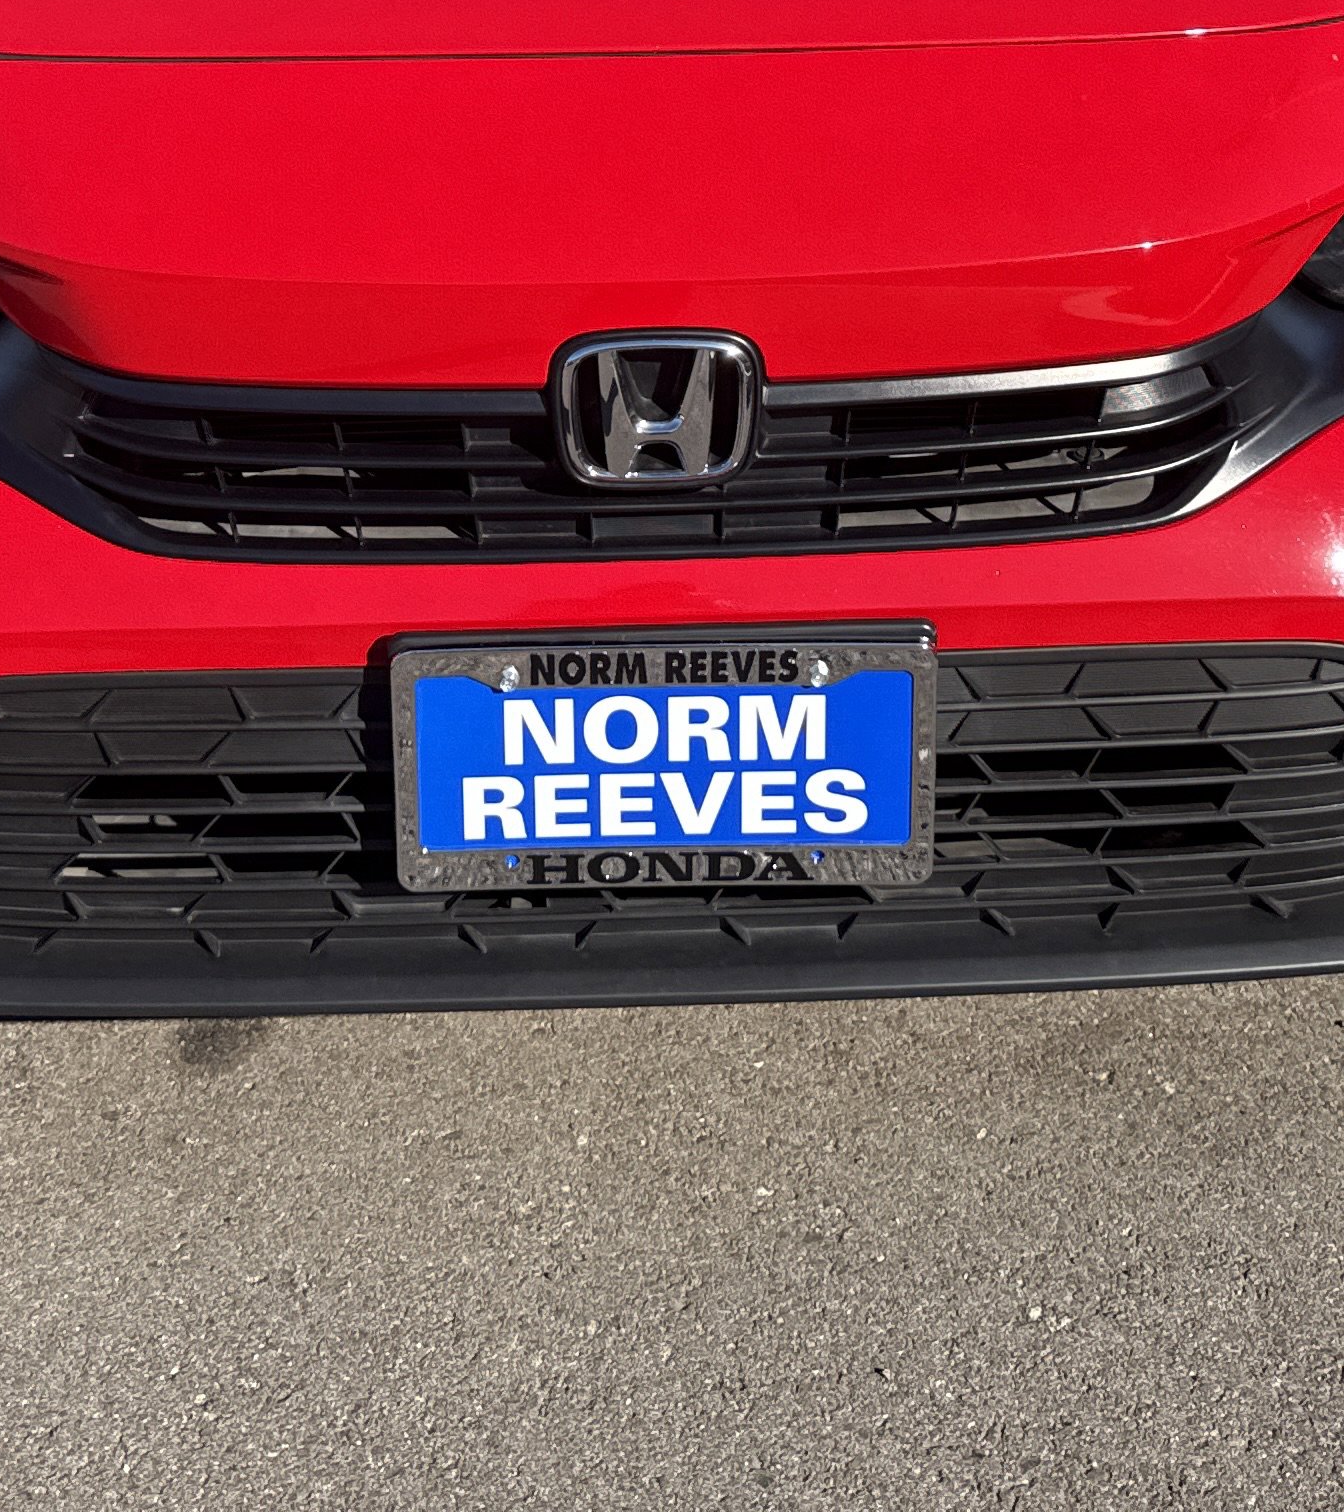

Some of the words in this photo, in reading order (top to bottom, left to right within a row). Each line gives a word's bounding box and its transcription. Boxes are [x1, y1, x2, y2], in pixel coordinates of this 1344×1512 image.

[530, 652, 648, 686] NORM
[665, 649, 799, 684] REEVES
[503, 694, 827, 766] NORM
[462, 769, 869, 841] REEVES
[526, 851, 814, 885] HONDA
